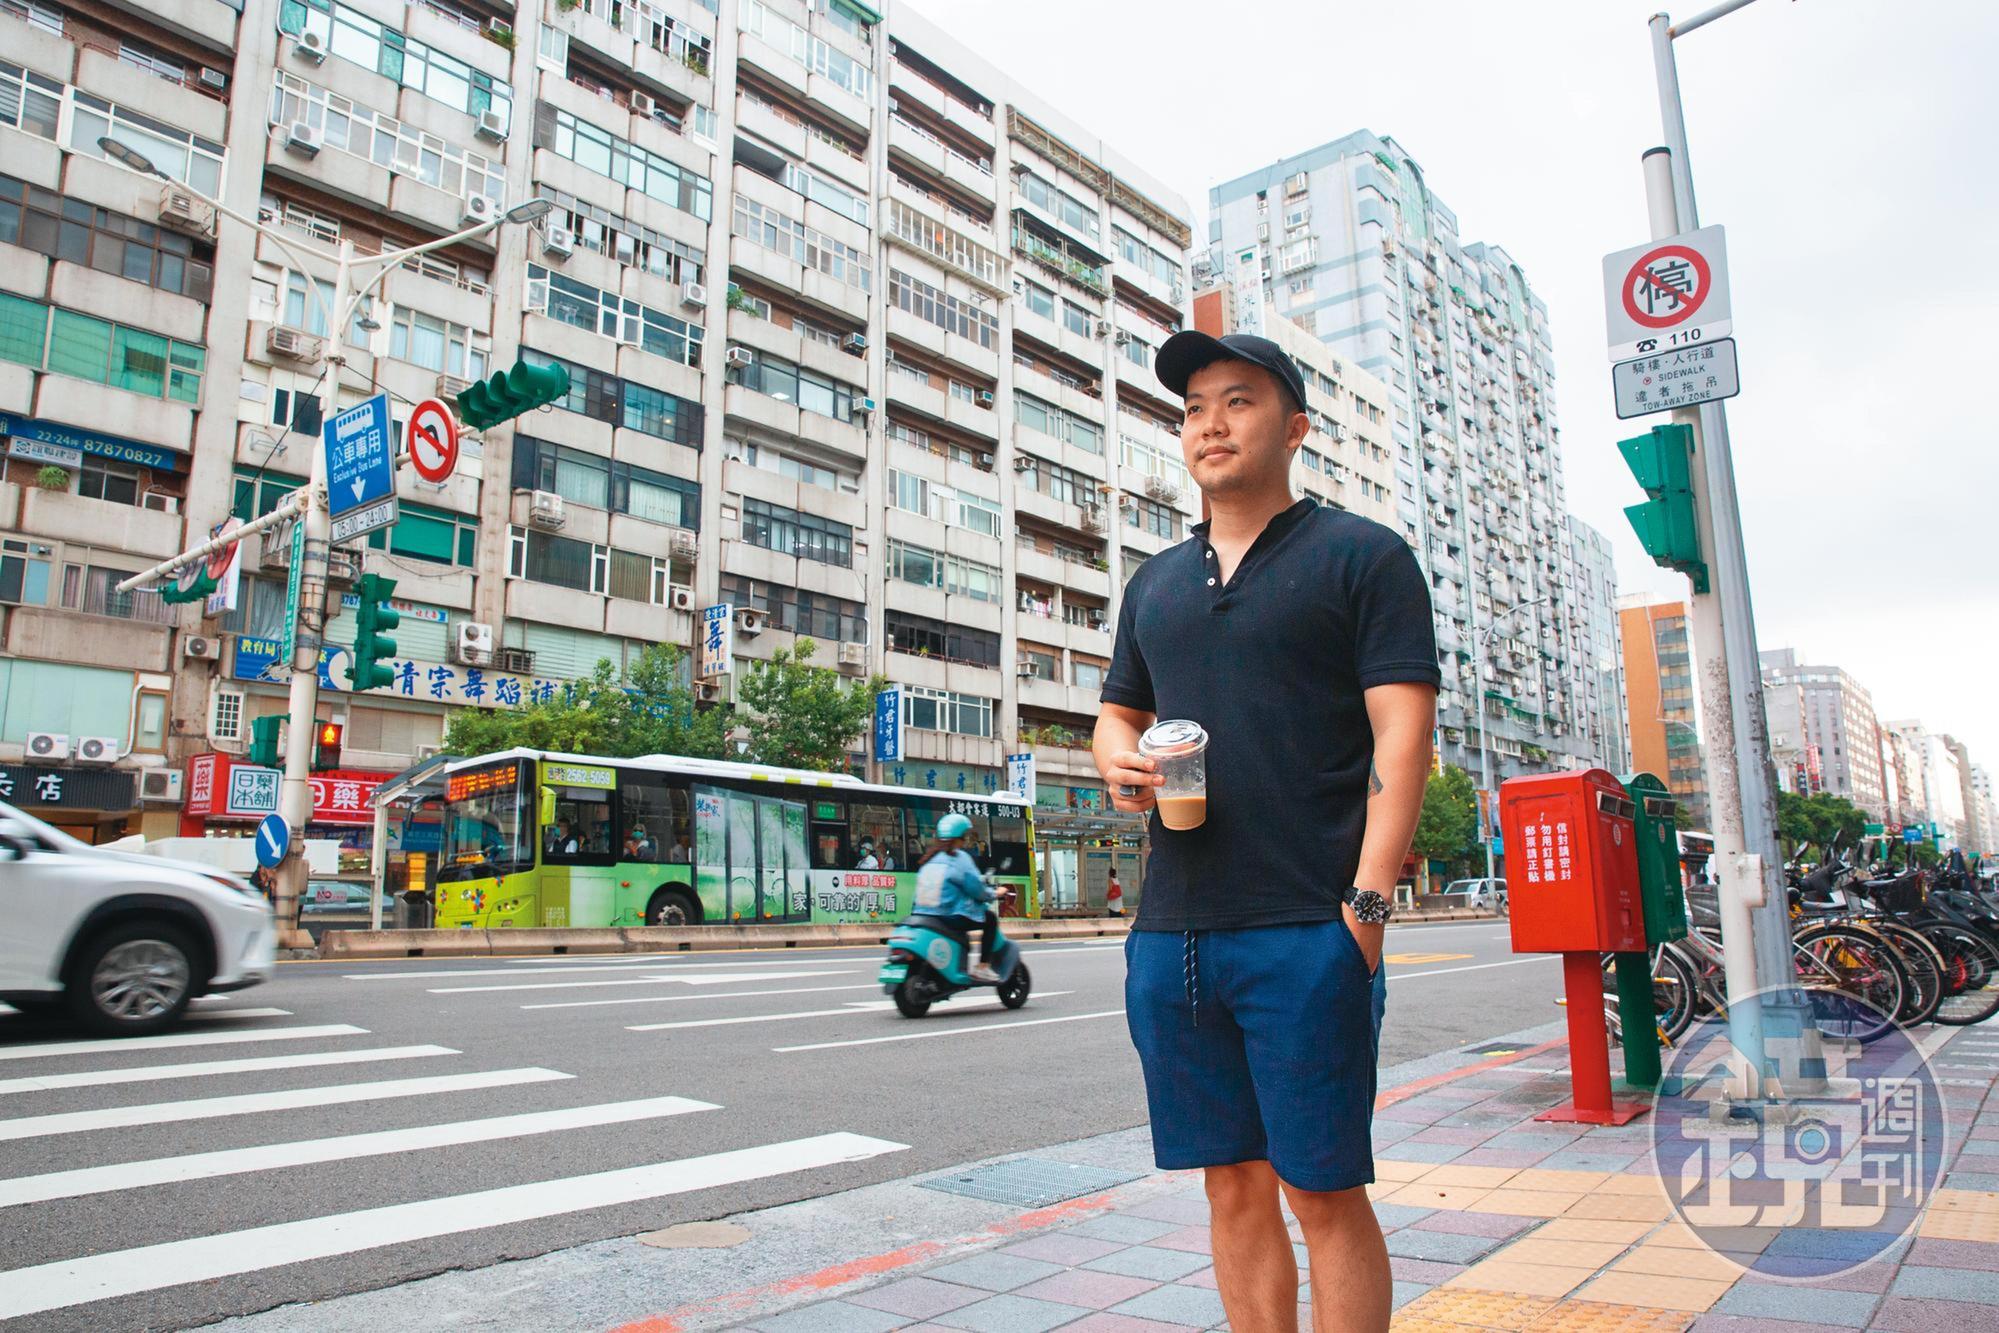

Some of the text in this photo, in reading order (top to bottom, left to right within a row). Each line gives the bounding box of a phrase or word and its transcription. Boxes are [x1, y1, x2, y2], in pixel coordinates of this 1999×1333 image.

[1639, 261, 1692, 314] 停
[1669, 328, 1701, 346] 110
[1658, 364, 1706, 382] SIDEWALK
[1634, 376, 1717, 403] 違者拖吊
[1642, 390, 1711, 411] TOW-AWAY ZONE
[83, 439, 163, 466] 87870827
[332, 429, 381, 470] 公車專用
[333, 455, 382, 484] Exclusive Bus Lane
[337, 516, 358, 537] 05:00
[365, 505, 388, 527] 24:00
[241, 639, 276, 657] 教育局
[884, 693, 896, 756] 竹君牙醫
[194, 763, 212, 798] 藥
[894, 766, 997, 791] 竹君牙科
[948, 801, 1021, 818] 大都會客運 500-U3
[1524, 825, 1540, 883] 郵票請正貼
[1540, 825, 1556, 882] 勿用釘書機
[1556, 822, 1572, 881] 信封請密封
